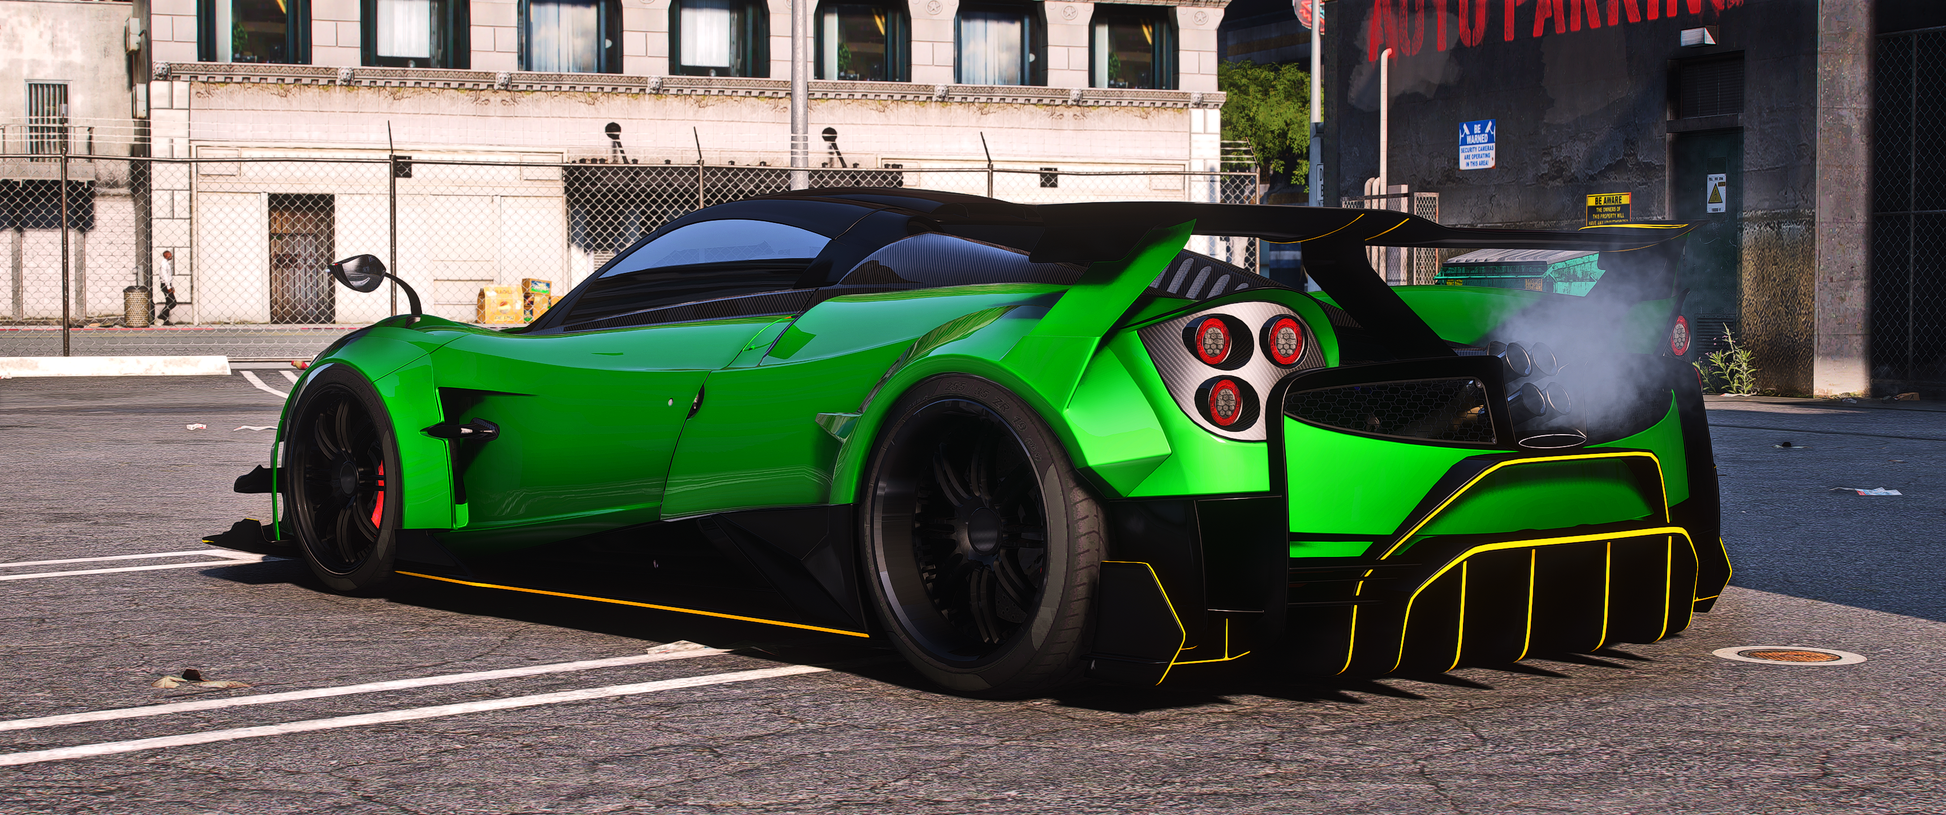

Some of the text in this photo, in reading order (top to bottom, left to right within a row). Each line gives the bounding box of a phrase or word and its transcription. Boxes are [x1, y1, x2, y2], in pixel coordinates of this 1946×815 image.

[1474, 124, 1481, 133] BE
[1466, 133, 1488, 144] WARNED
[1471, 152, 1490, 160] OPERATING
[1595, 195, 1622, 205] BE AWARE
[992, 395, 1010, 413] ZR
